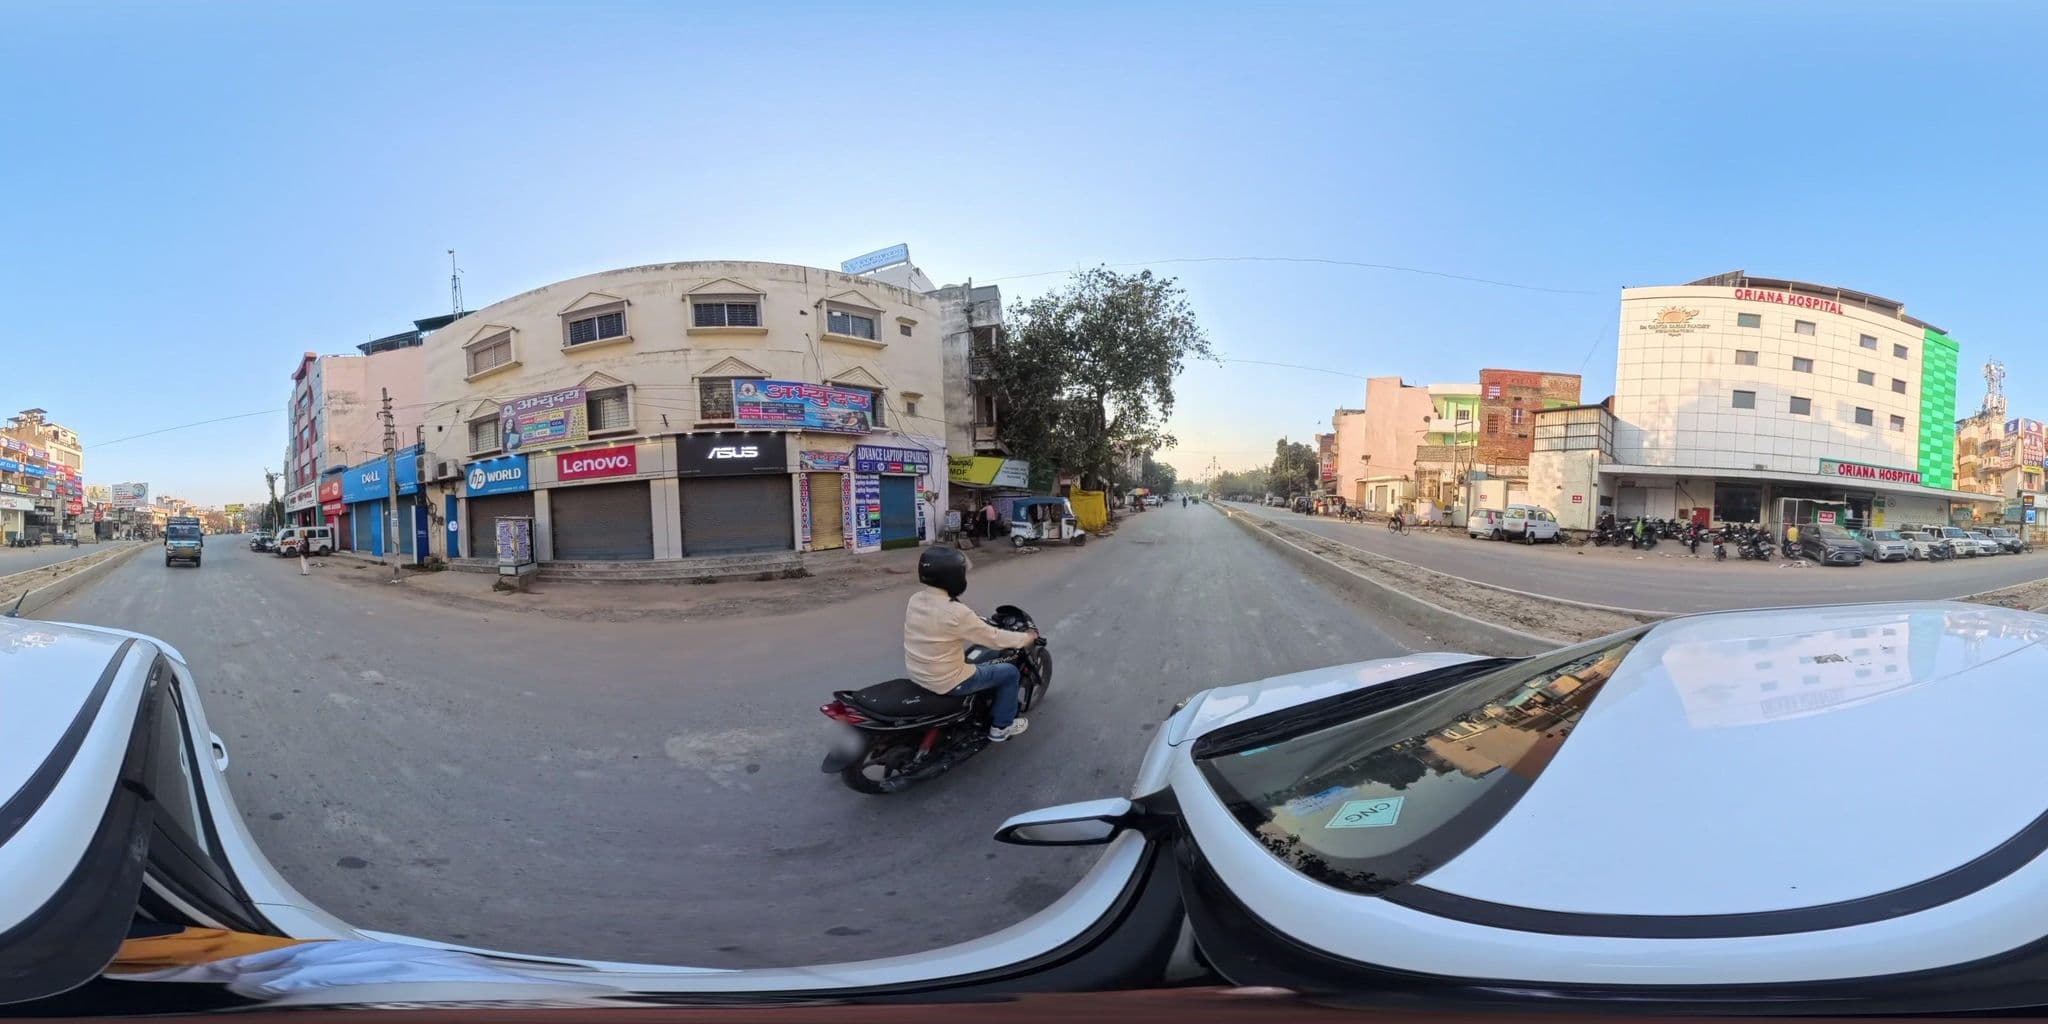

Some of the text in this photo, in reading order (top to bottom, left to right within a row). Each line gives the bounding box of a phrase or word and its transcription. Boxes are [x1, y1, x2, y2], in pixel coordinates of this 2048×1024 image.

[1734, 288, 1843, 315] ORIANA HOSPITAL
[765, 384, 869, 408] अभ्युदय
[708, 446, 759, 459] ASUS
[857, 447, 929, 464] ADVANCE LAPTOP REPAIRING
[563, 455, 629, 474] Lenovo
[1838, 463, 1920, 484] ORIANA HOSPITAL
[361, 470, 380, 484] DELL
[470, 467, 521, 490] hp WORLD
[1344, 802, 1391, 823] CNG
